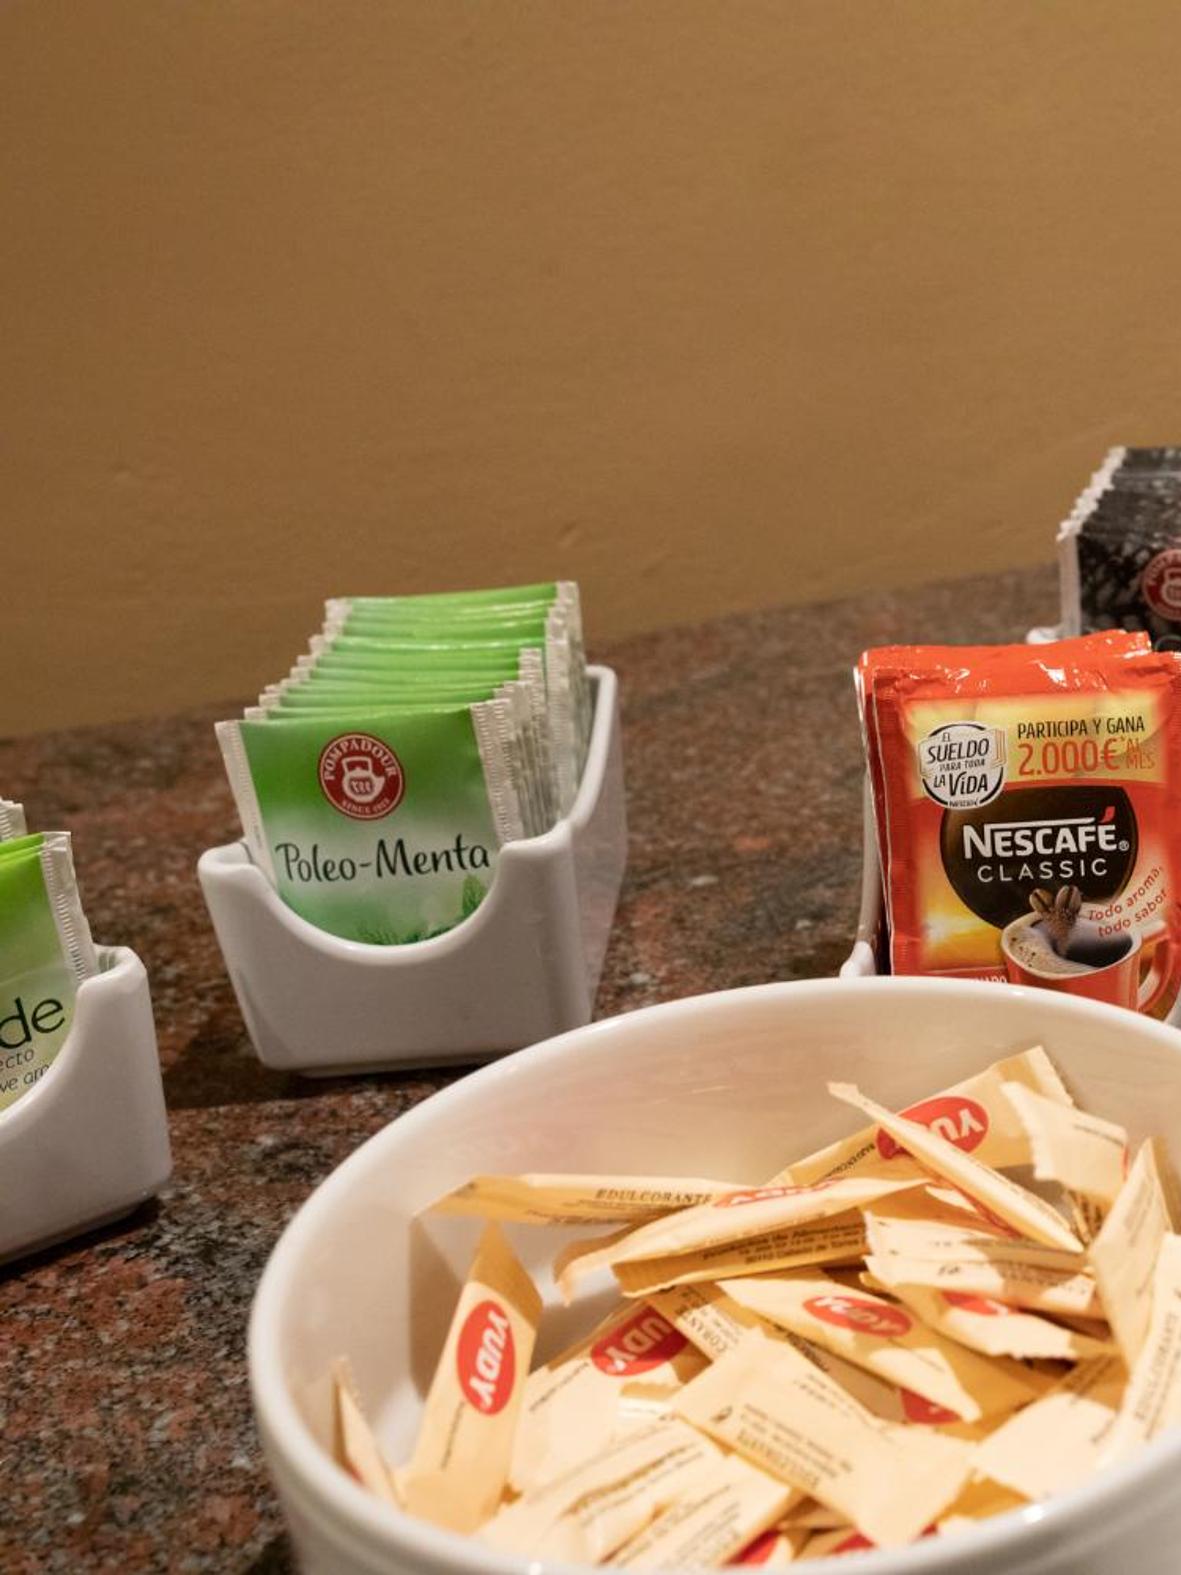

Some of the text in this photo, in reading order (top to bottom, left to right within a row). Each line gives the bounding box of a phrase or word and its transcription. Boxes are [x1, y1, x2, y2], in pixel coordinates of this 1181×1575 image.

[1017, 716, 1145, 740] PARTICIPA Y GANA
[324, 738, 397, 780] POMPADOUR
[927, 738, 990, 764] SUELDO
[939, 762, 962, 772] PARA
[1125, 752, 1156, 770] MES
[933, 774, 946, 788] LA
[962, 806, 1117, 859] NESCAFÉ
[275, 833, 490, 882] Poleo-Menta
[977, 858, 1108, 883] CLASSIC
[1097, 888, 1168, 937] todo sabor
[469, 1309, 509, 1408] YUDY
[605, 1316, 673, 1373] UDY
